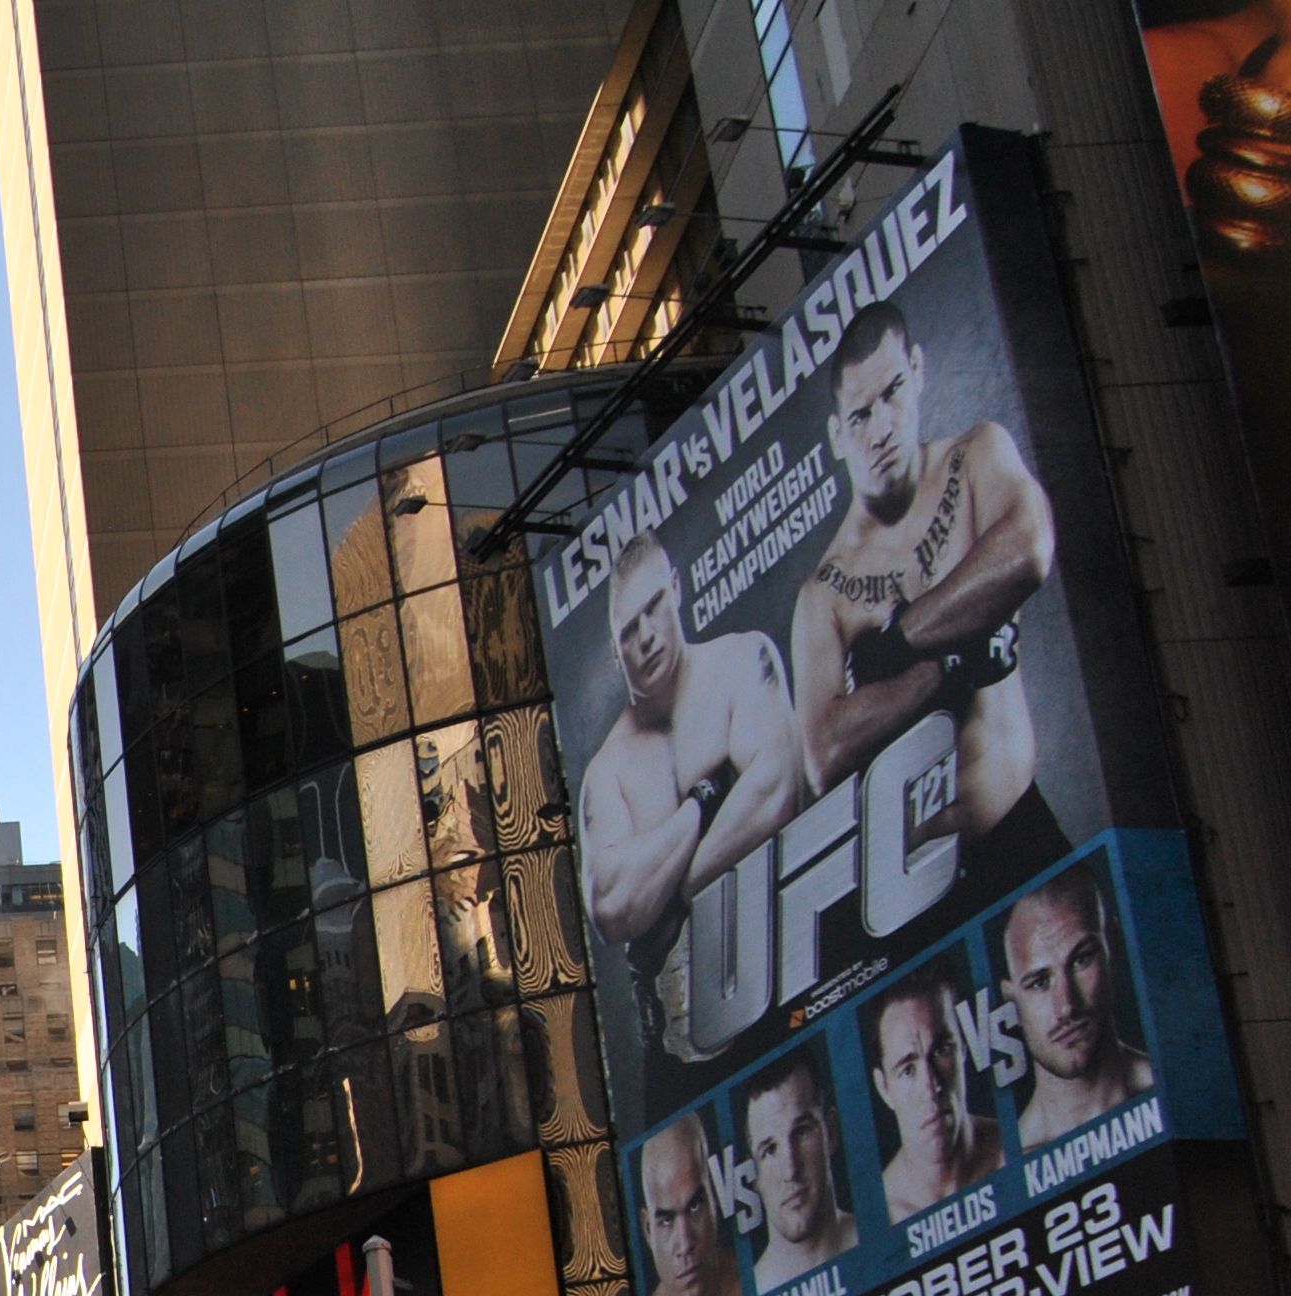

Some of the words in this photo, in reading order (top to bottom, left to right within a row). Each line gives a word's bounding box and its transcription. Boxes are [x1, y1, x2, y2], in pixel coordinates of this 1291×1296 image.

[544, 447, 687, 630] LESNAR
[706, 150, 967, 464] VELASQUEZ
[691, 443, 825, 591] HEAVYWEIGHT
[714, 440, 784, 527] WORLD
[694, 482, 837, 633] CHAMPIONSHIP
[688, 709, 960, 1053] UFC
[1023, 1097, 1165, 1199] KAMPMANN
[906, 1184, 997, 1259] SHIELDS
[1044, 1181, 1122, 1253] 23
